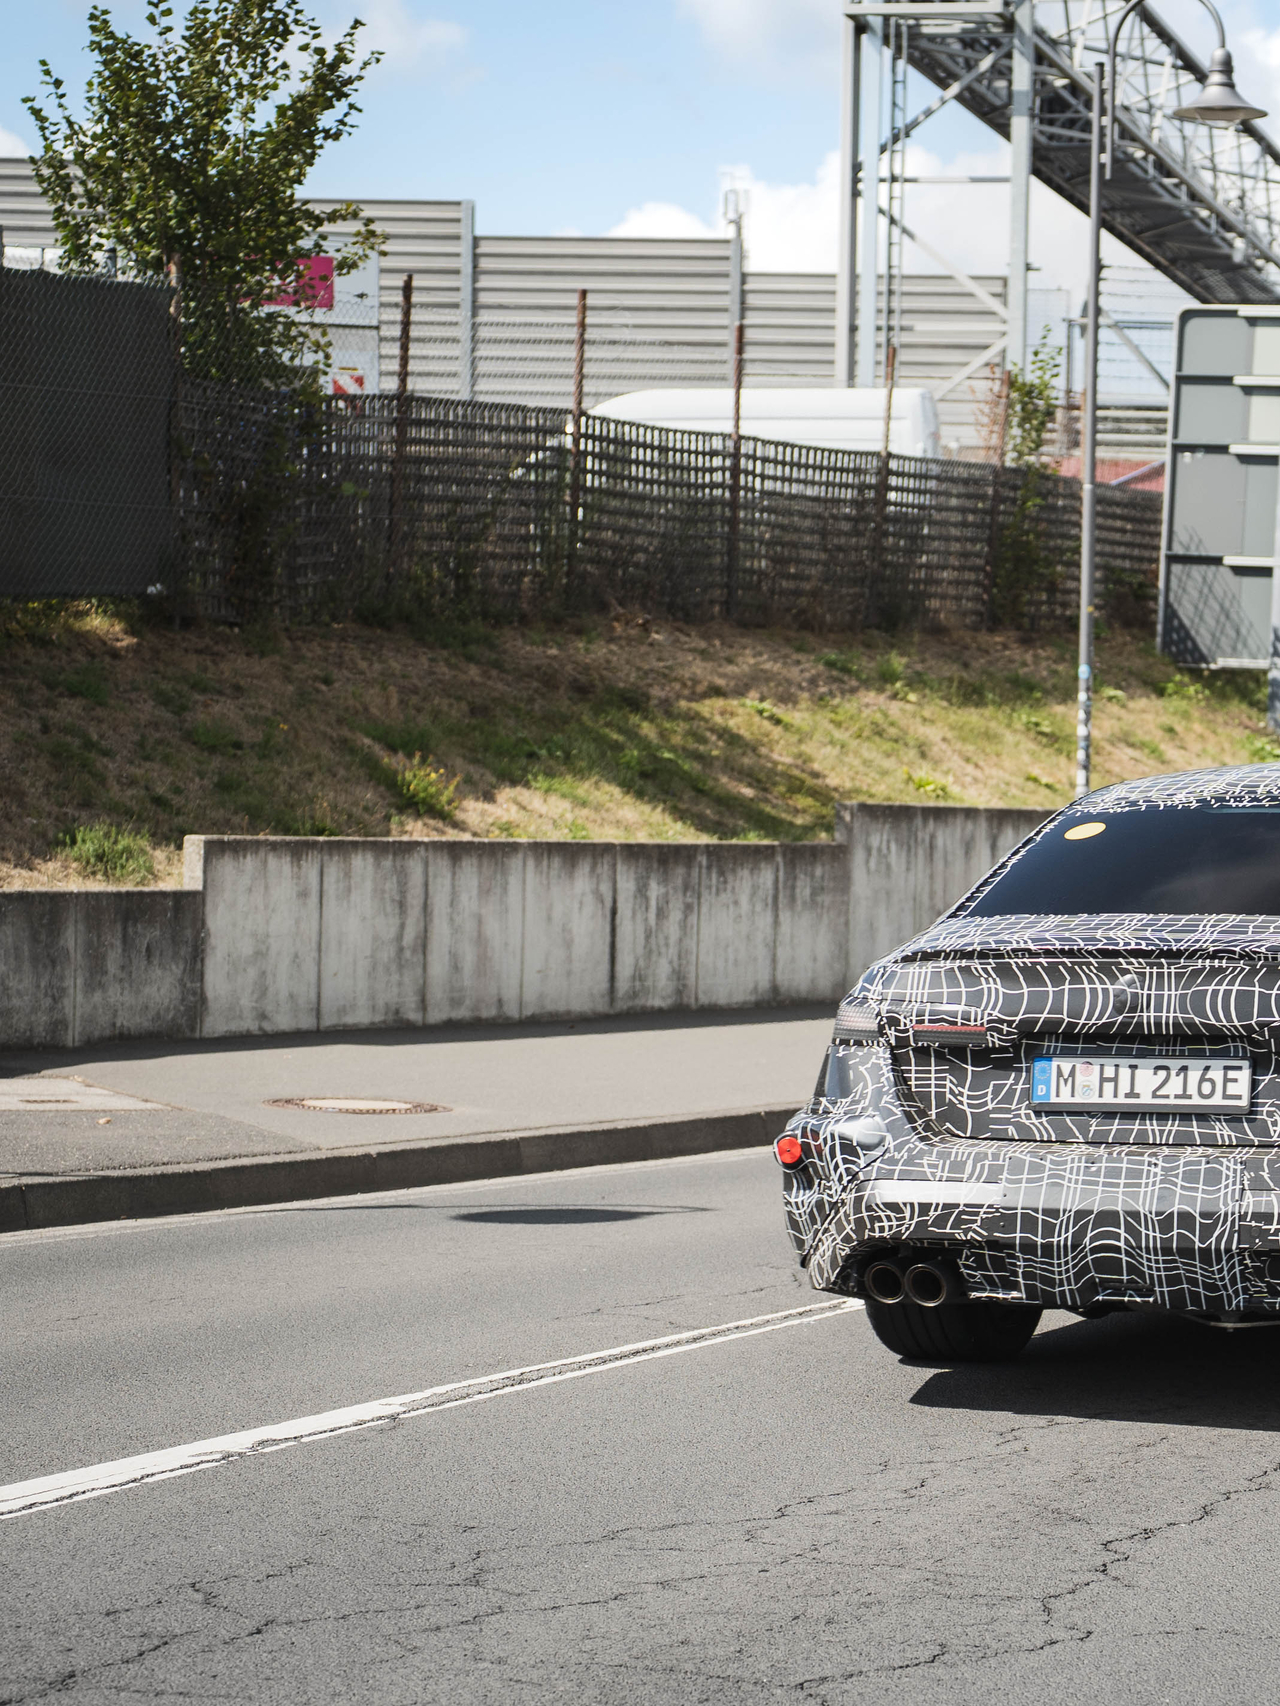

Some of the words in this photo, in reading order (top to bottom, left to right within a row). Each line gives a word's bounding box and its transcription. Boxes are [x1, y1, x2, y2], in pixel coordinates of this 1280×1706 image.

[1037, 1084, 1047, 1096] D
[1056, 1063, 1077, 1098] M
[1098, 1063, 1141, 1099] HI
[1151, 1064, 1244, 1101] 216E
